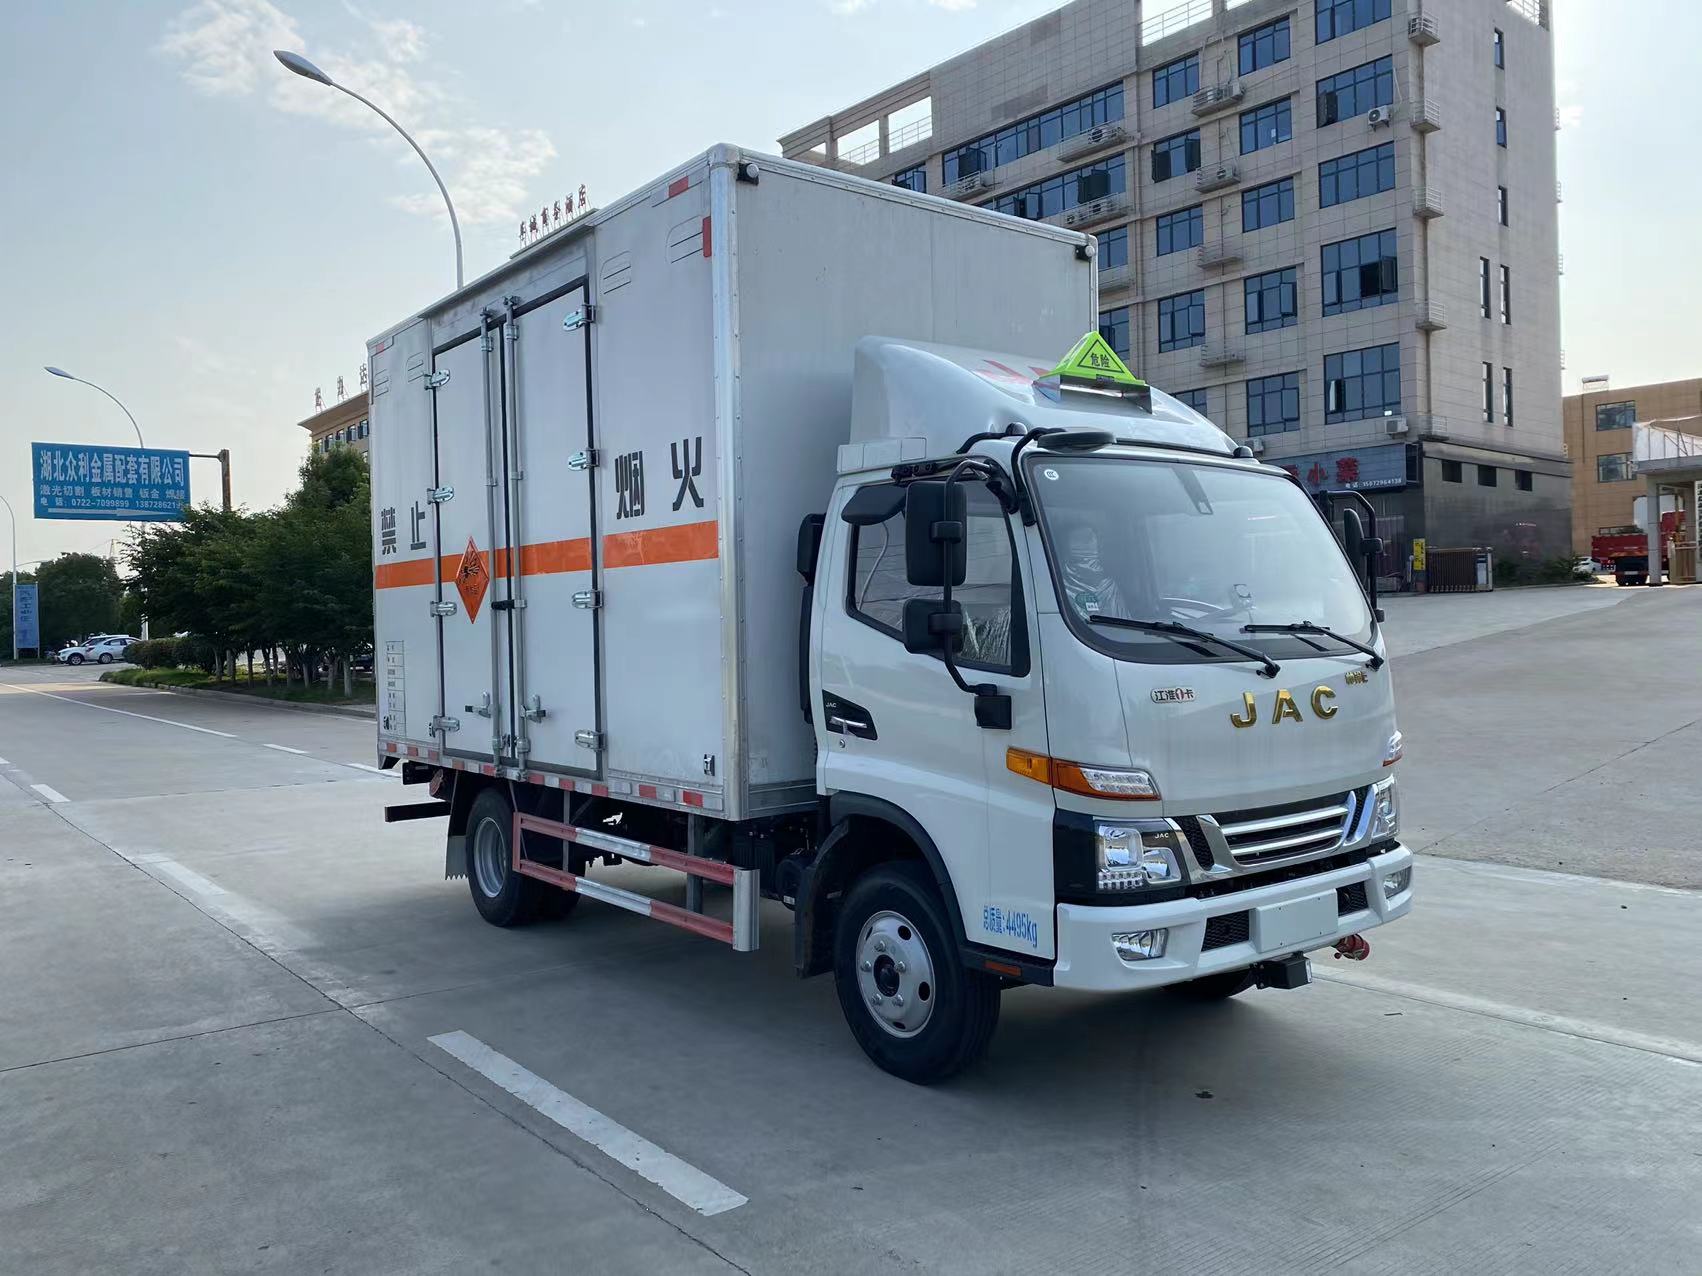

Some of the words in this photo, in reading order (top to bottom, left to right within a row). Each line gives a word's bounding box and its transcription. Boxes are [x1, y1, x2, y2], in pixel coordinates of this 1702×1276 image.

[1090, 353, 1110, 368] 危险
[40, 450, 185, 487] 湖北众利金属配套有限公司
[1230, 685, 1339, 728] JAC
